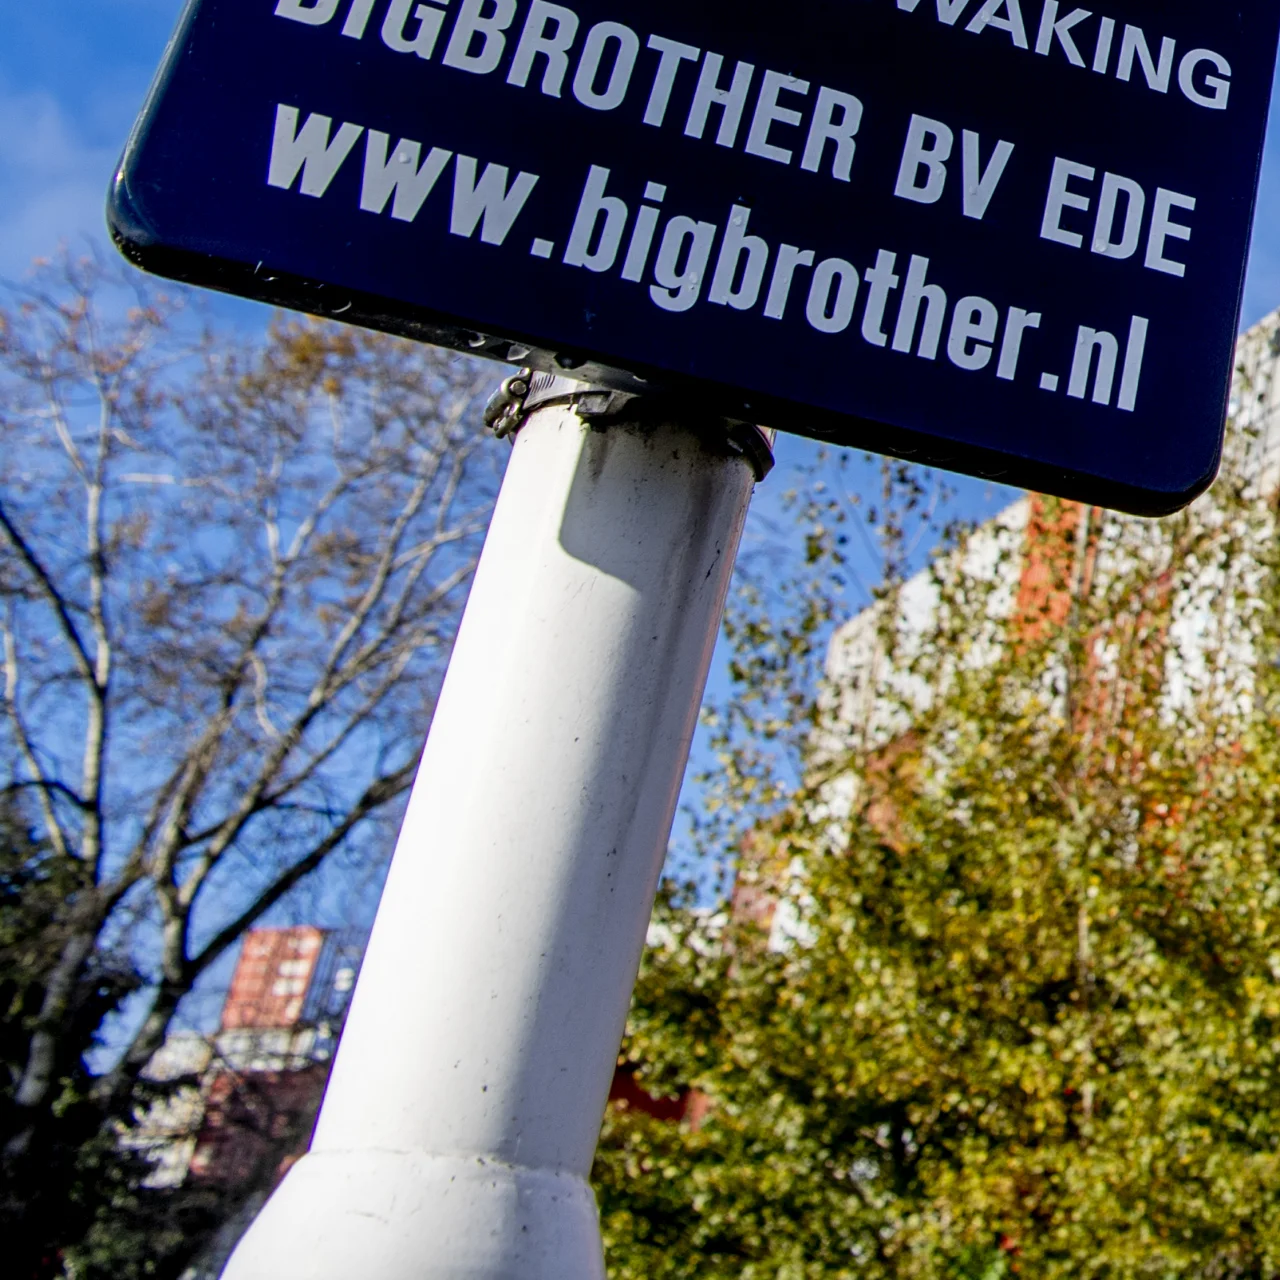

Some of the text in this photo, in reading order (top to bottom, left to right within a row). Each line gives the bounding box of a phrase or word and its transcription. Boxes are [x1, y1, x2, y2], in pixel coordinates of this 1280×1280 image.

[268, 104, 1148, 411] www.bigbrother.nl
[894, 114, 1014, 219] BV
[1040, 157, 1196, 277] EDE
